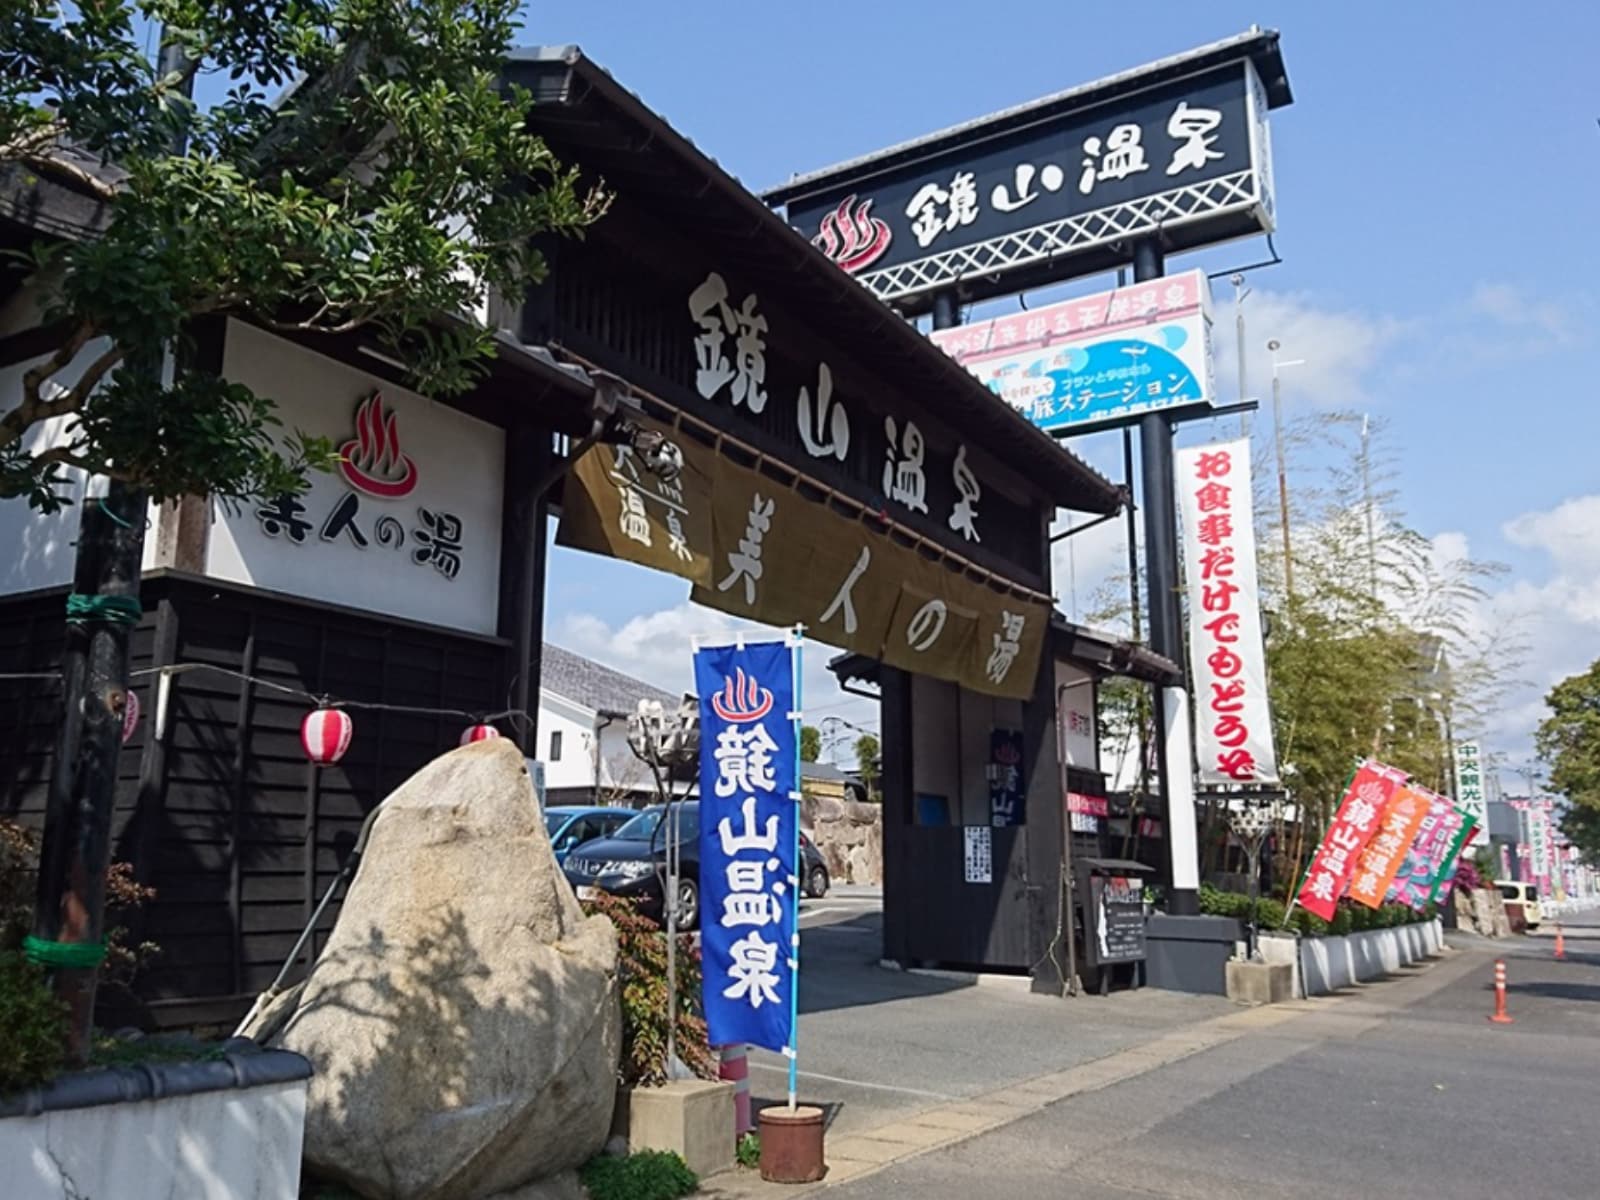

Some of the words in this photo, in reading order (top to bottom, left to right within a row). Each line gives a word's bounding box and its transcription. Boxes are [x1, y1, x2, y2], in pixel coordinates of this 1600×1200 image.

[905, 101, 1226, 247] 鏡山温泉
[687, 272, 983, 543] 鏡山温泉
[718, 492, 1026, 684] 美人の湯
[1194, 450, 1255, 781] お食事だけでもどうぞ
[1309, 797, 1376, 903] 鏡山温泉
[1359, 813, 1411, 897] 天然温泉
